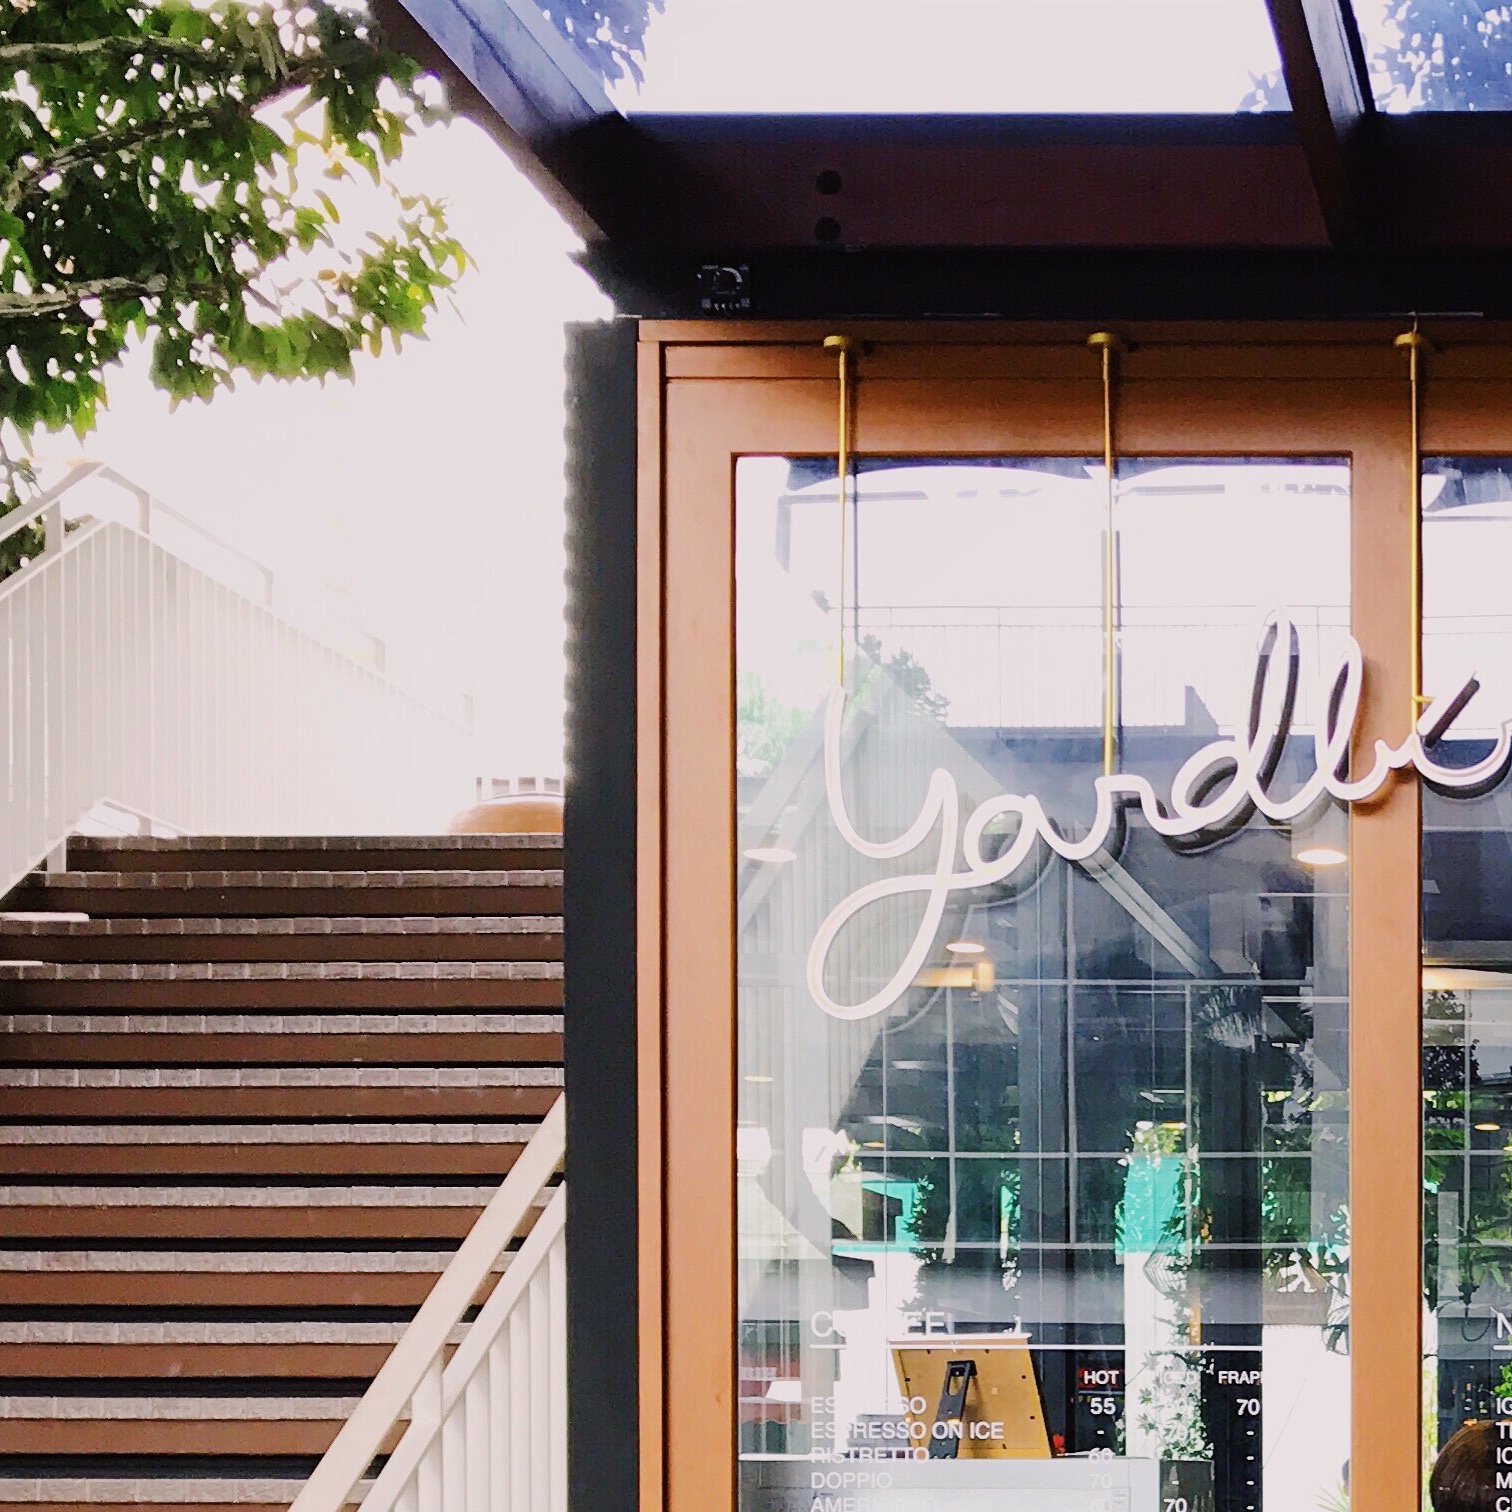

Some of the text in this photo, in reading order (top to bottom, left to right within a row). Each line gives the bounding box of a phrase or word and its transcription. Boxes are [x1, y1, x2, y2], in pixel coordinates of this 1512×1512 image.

[1083, 1370, 1120, 1385] HOT
[1218, 1370, 1264, 1385] FRAP
[1090, 1398, 1116, 1415] 55
[1236, 1399, 1260, 1416] 70
[932, 1421, 964, 1440] ON
[970, 1421, 1004, 1440] ICE
[810, 1446, 930, 1464] RISTRETTO
[810, 1471, 893, 1489] DOPPIO
